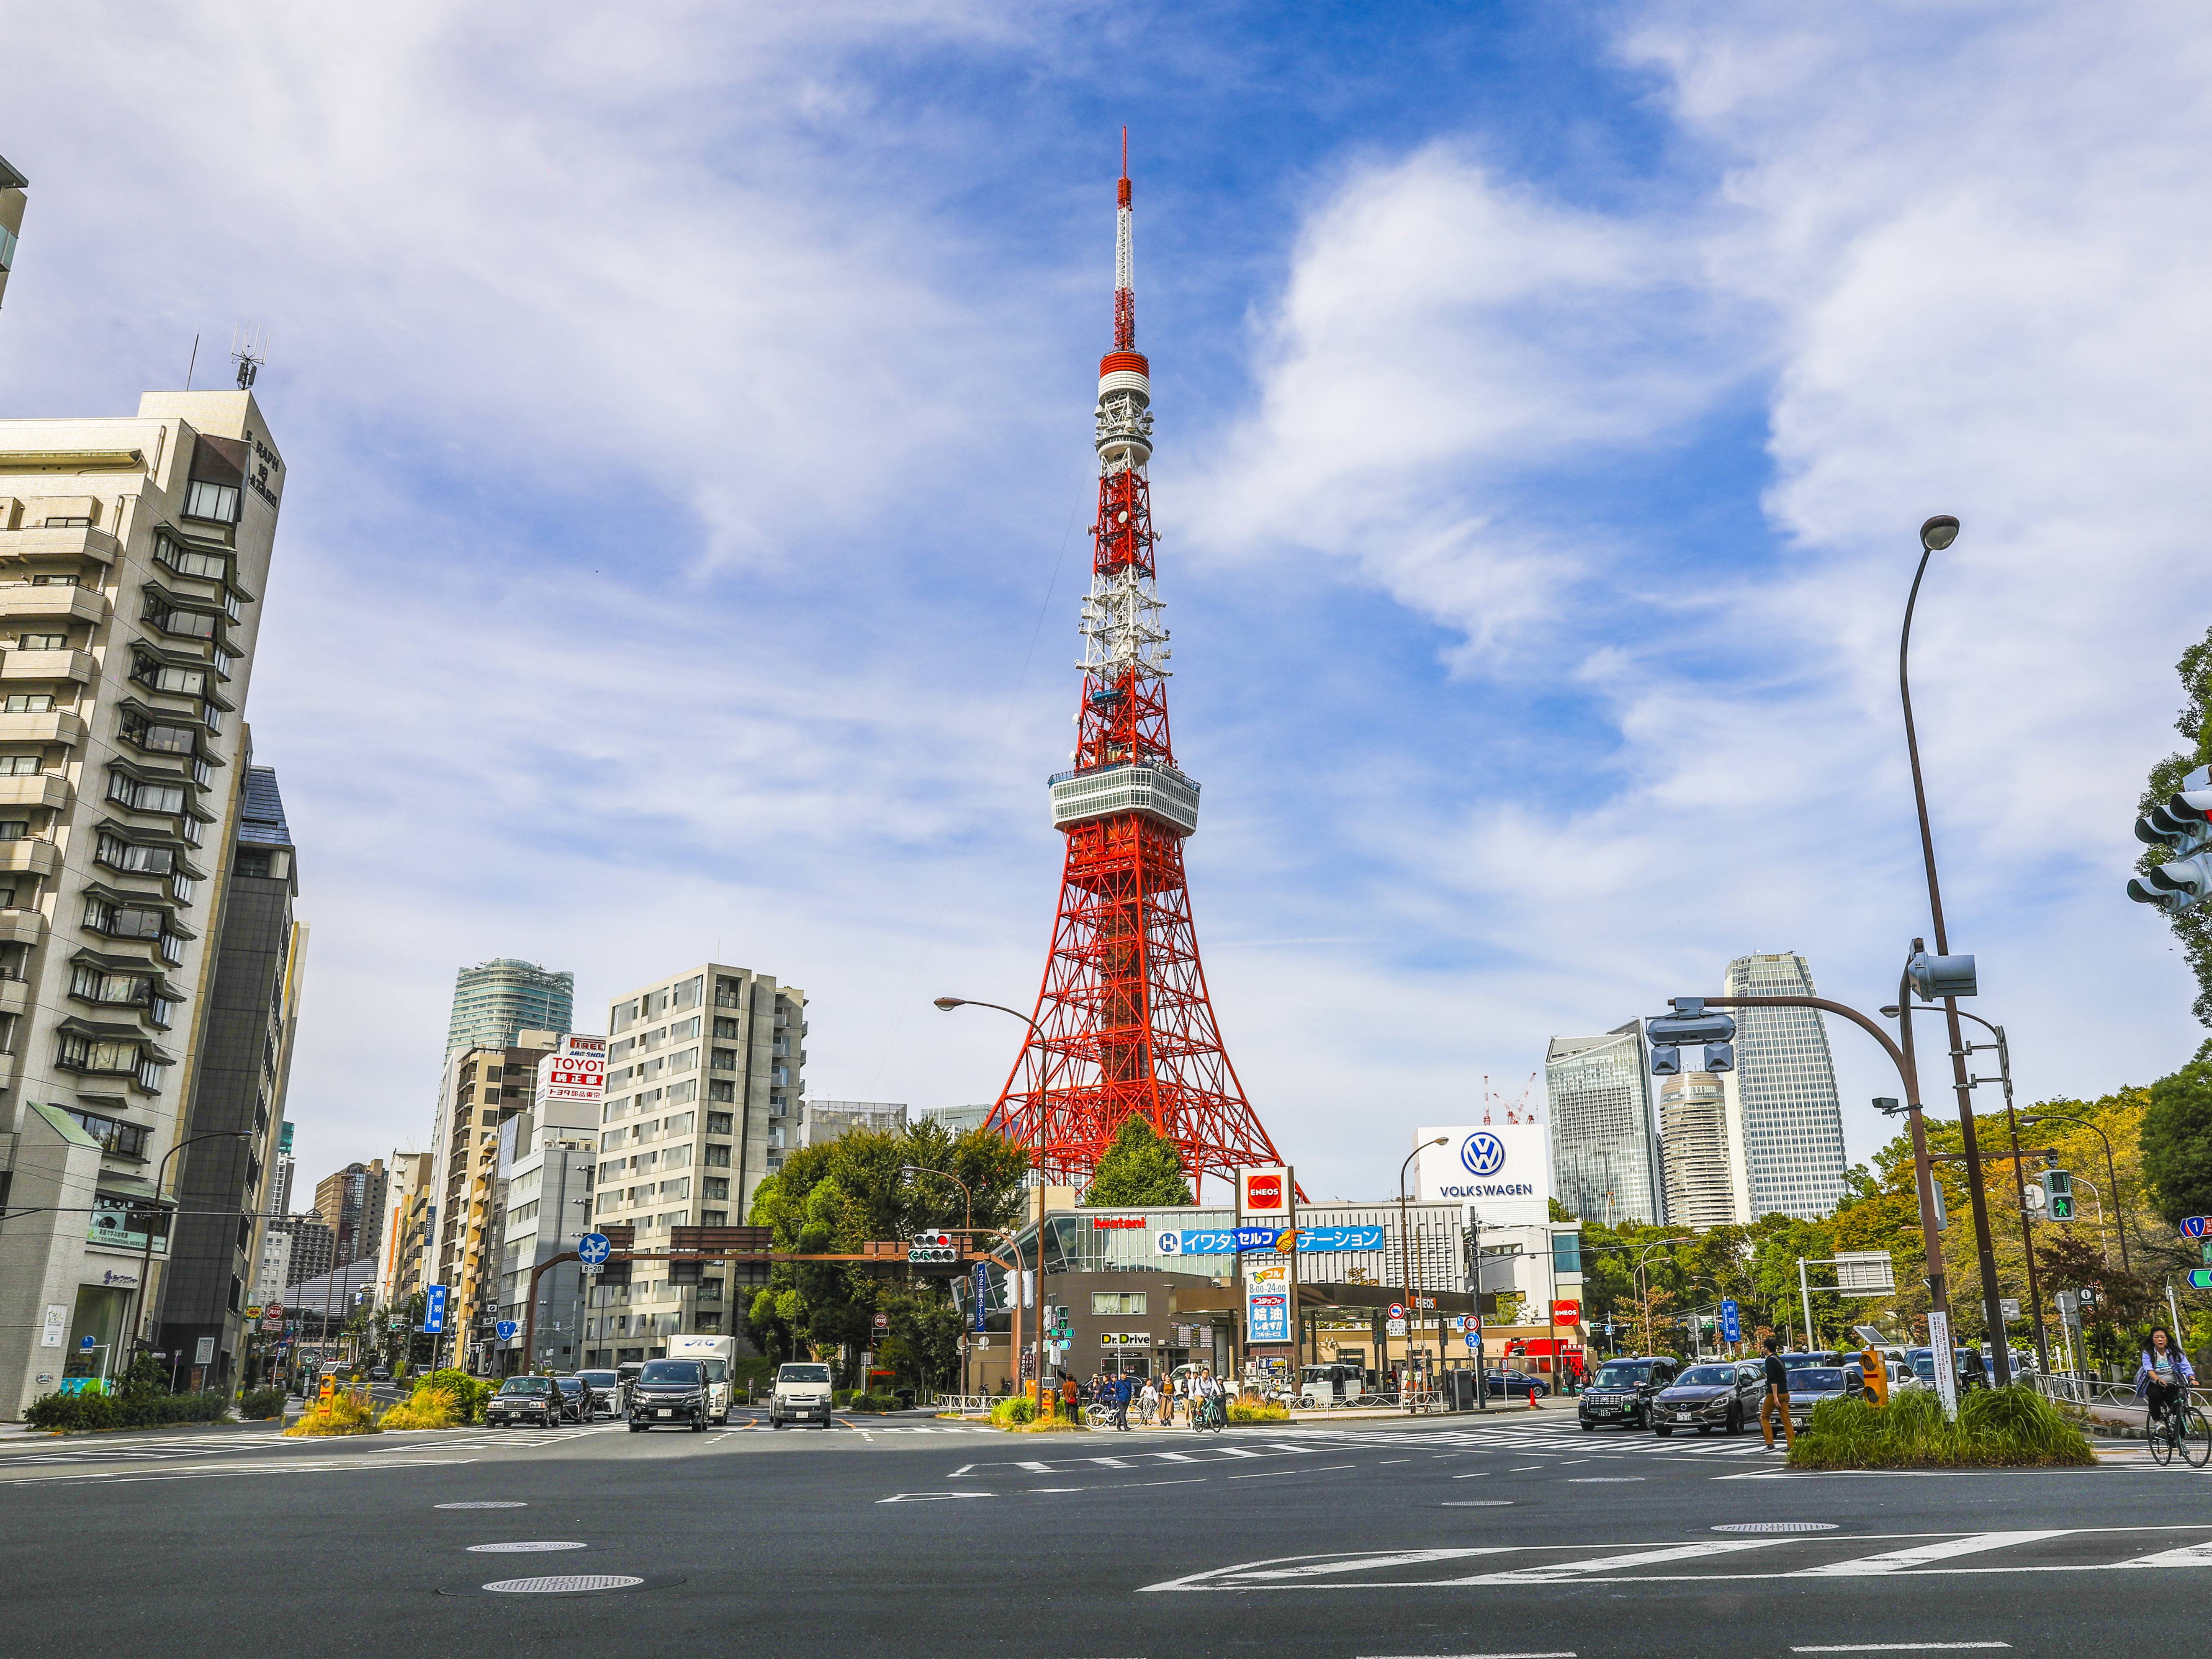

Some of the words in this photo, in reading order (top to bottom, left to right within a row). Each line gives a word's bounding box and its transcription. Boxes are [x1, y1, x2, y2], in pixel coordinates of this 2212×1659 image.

[555, 1073, 603, 1085] 純正部
[550, 1089, 600, 1098] トヨタ部品東京
[1440, 1184, 1533, 1198] VOLKSWAGEN
[1094, 1217, 1146, 1229] Iwatani
[2193, 1220, 2199, 1232] 1
[1238, 1232, 1273, 1245] セルフ
[432, 1290, 443, 1327] 赤羽橋
[1254, 1307, 1283, 1321] 給油
[1727, 1306, 1736, 1336] 赤羽橋
[1102, 1334, 1117, 1344] Dr.
[1119, 1334, 1150, 1344] Drive
